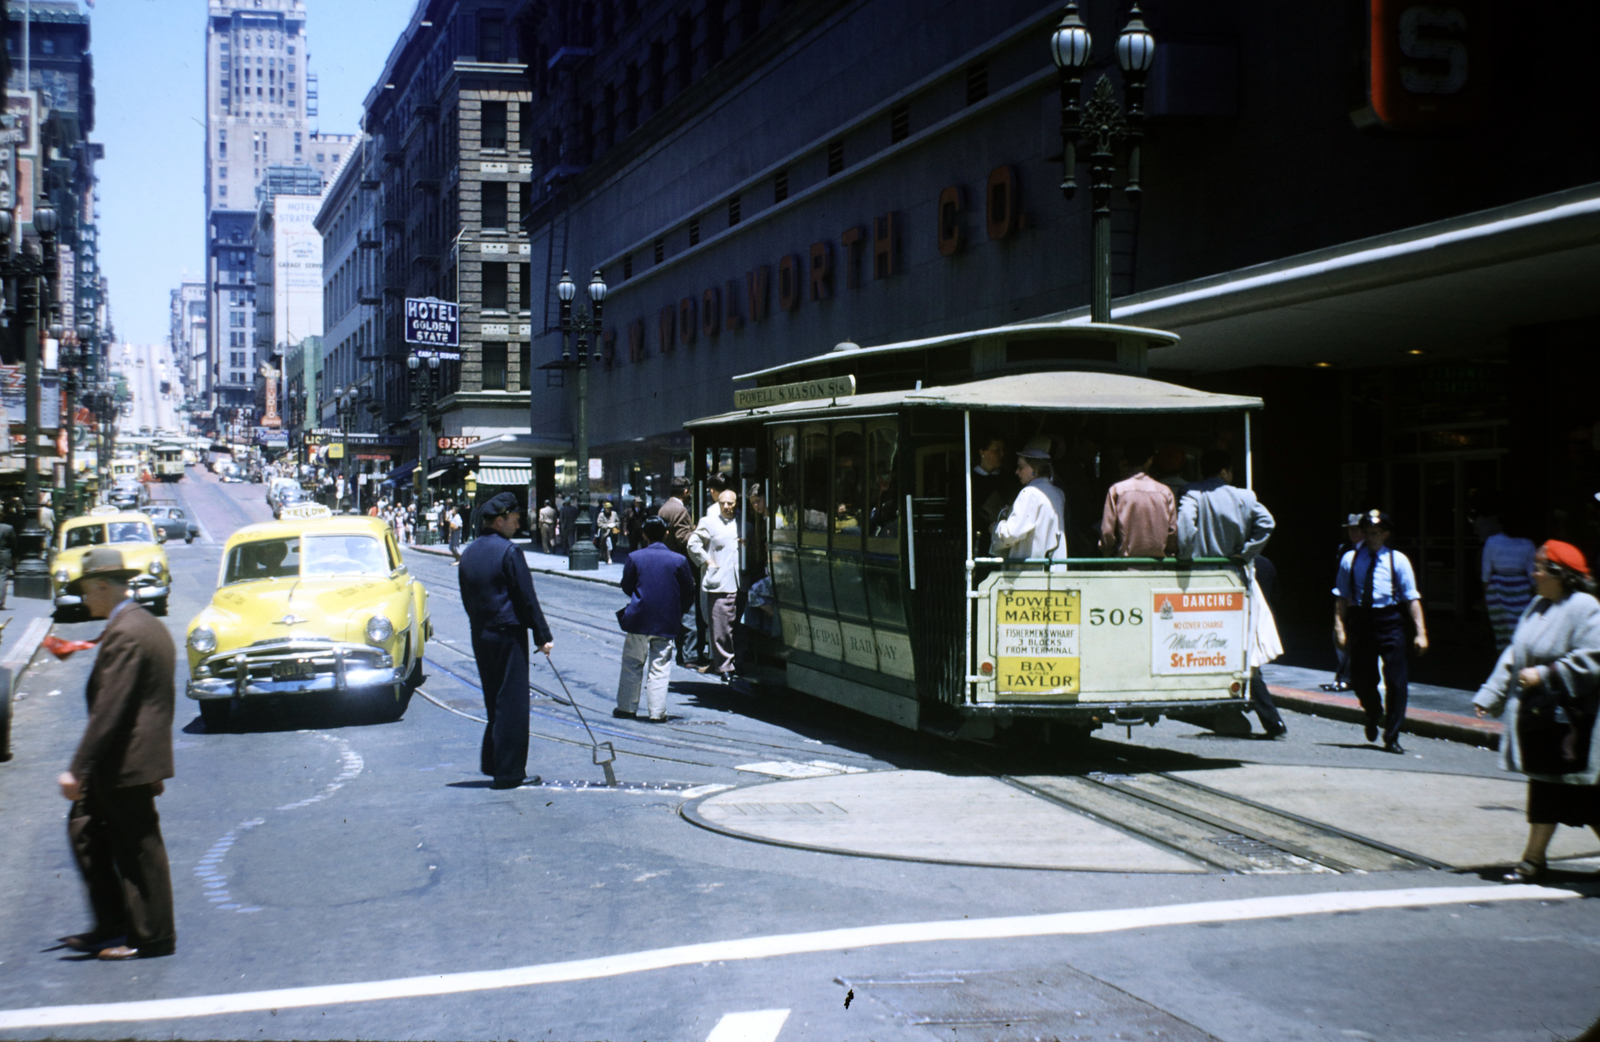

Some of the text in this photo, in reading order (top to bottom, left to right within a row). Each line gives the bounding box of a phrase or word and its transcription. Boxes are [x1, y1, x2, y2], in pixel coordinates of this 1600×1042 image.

[288, 202, 317, 212] HOTEL
[80, 230, 95, 288] MANX
[658, 210, 903, 353] WOOLWORTH
[937, 164, 1036, 256] CO.
[408, 301, 456, 322] HOTEL
[412, 319, 452, 332] GOLDEN
[416, 331, 449, 342] STATE
[739, 390, 775, 405] POWELL
[788, 383, 824, 400] MASON
[438, 437, 451, 449] ED
[285, 507, 328, 518] YELLOW
[1006, 596, 1073, 607] POWELL
[1182, 594, 1233, 607] DANCING
[1005, 610, 1073, 621] MARKET
[1089, 607, 1143, 626] 508
[1173, 620, 1224, 630] NO COVER CHARGE
[1050, 629, 1074, 638] WHARF
[793, 623, 898, 660] MUNICIPAL RAILWAY
[1018, 638, 1062, 646] 3 BLOCKS
[1006, 646, 1073, 655] FROM TERMINAL
[1021, 661, 1057, 671] BAY
[1170, 652, 1226, 668] St. Francis
[1005, 675, 1073, 687] TAYLOR
